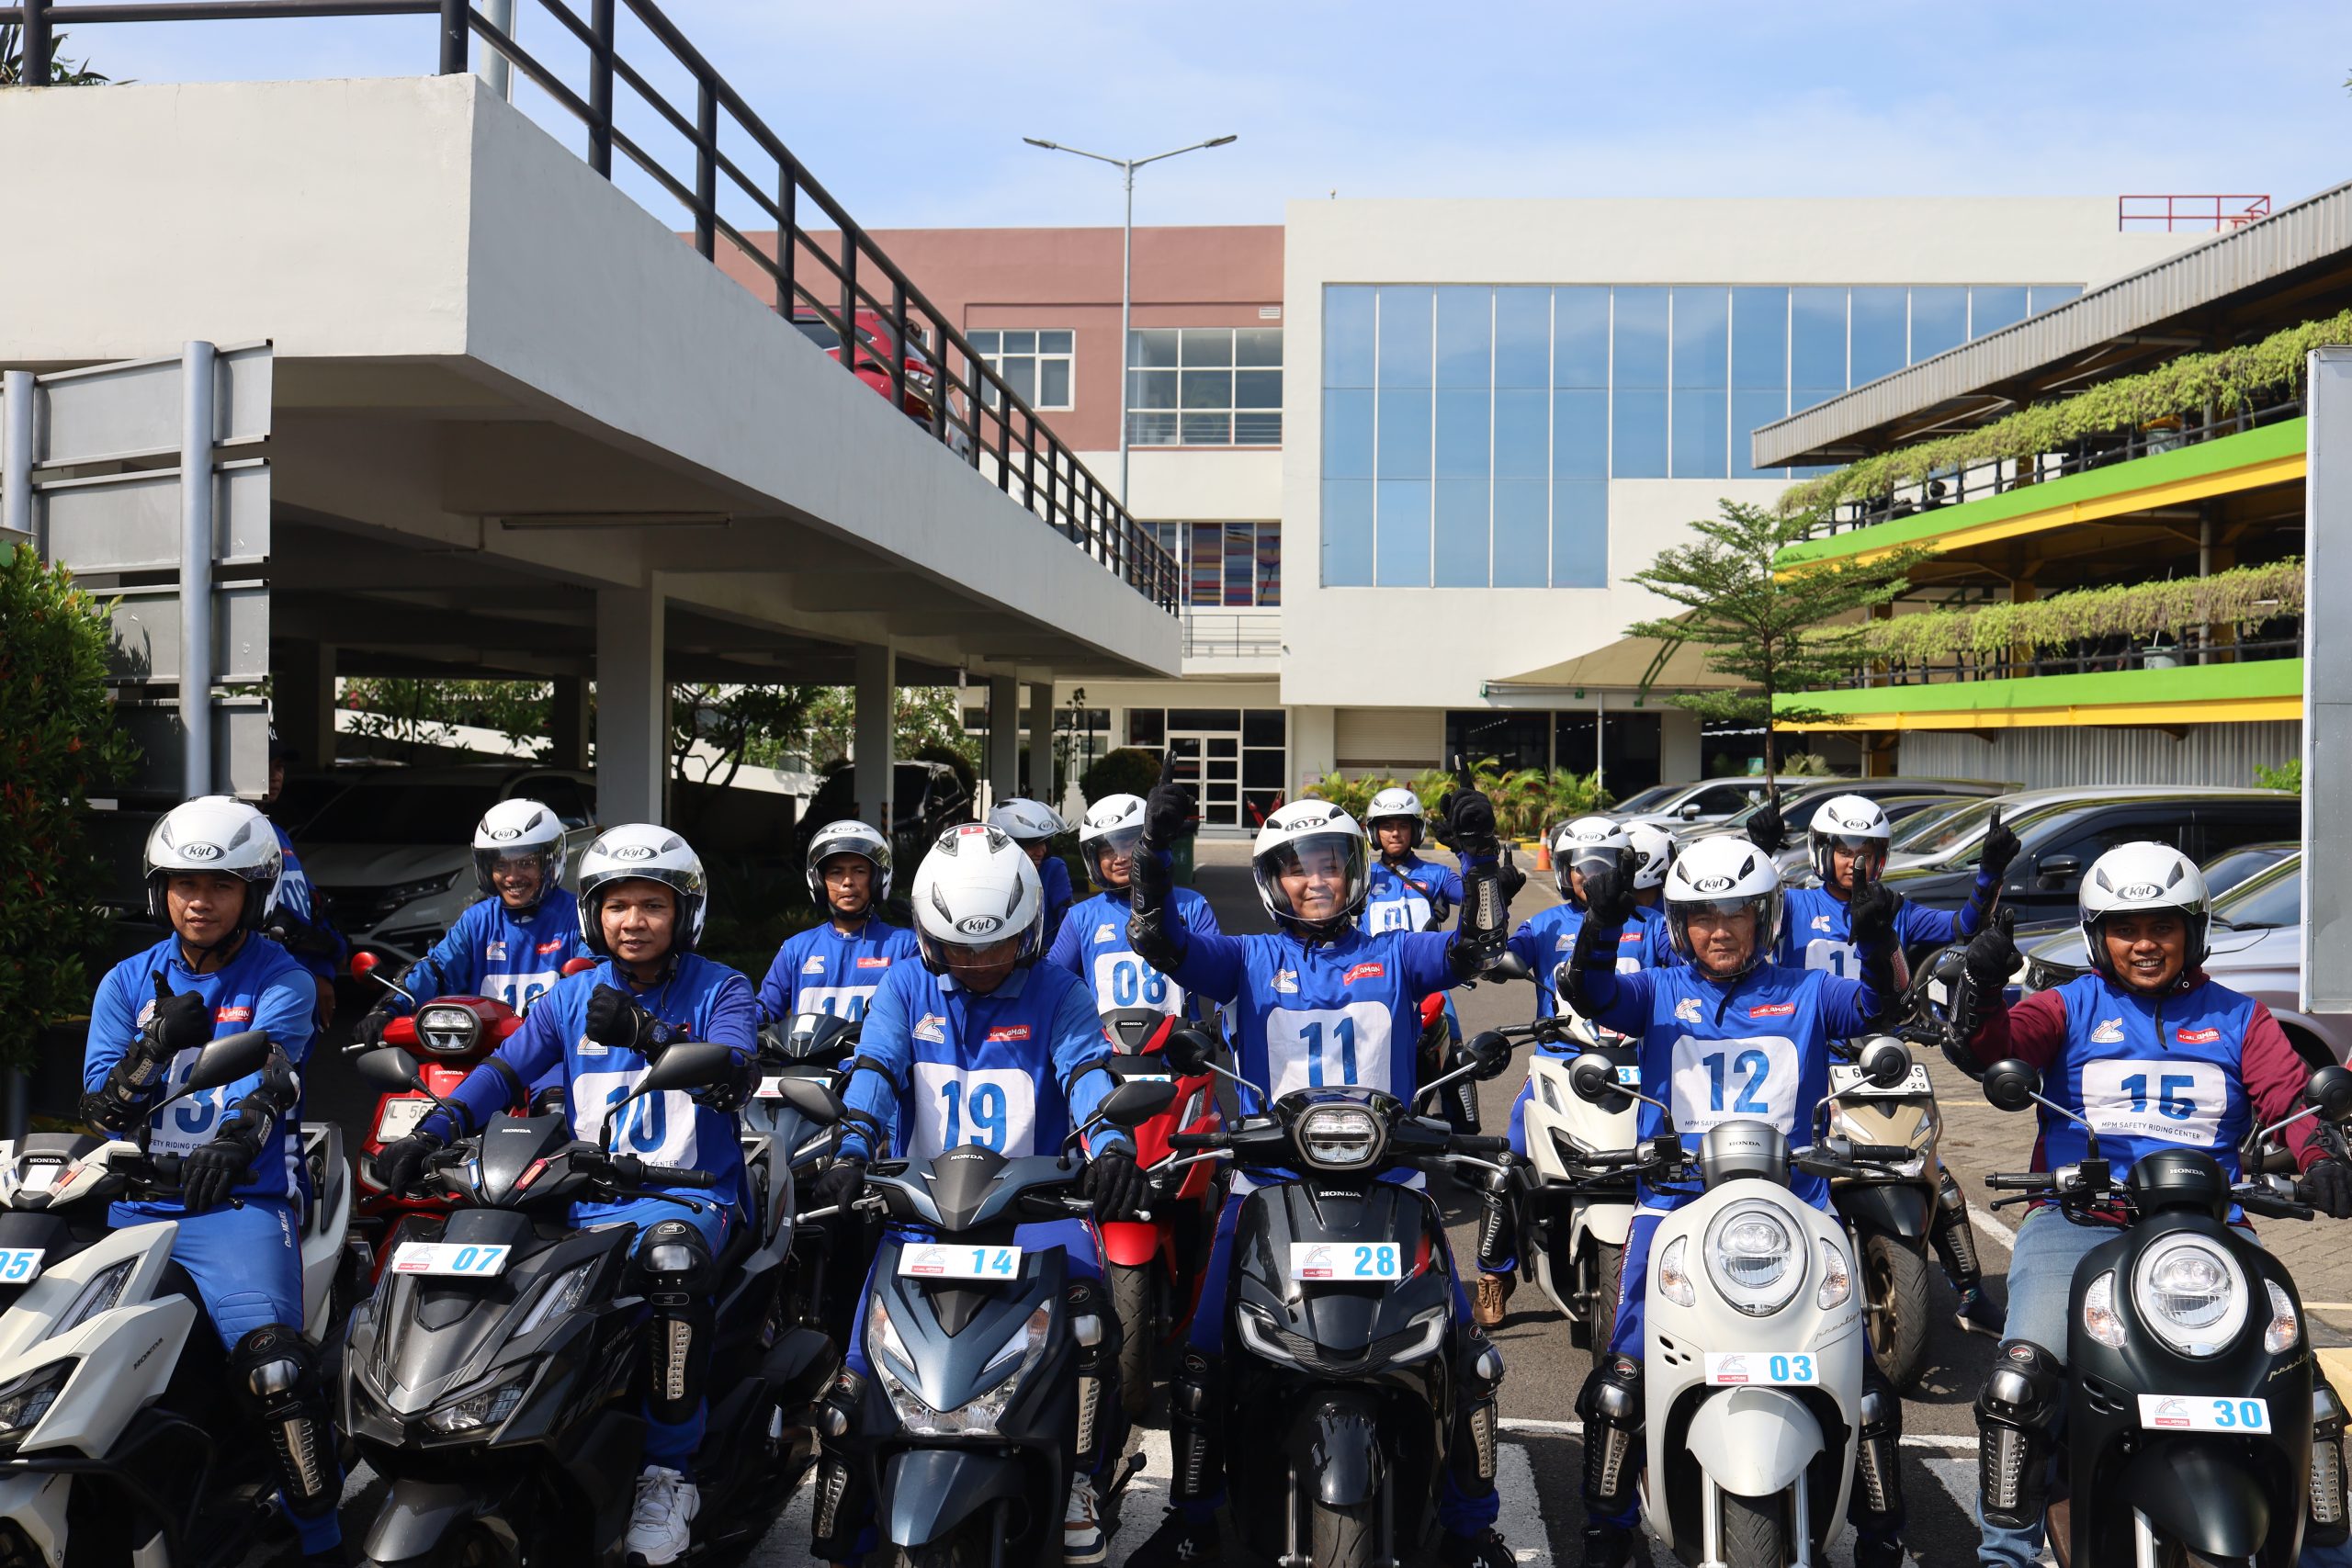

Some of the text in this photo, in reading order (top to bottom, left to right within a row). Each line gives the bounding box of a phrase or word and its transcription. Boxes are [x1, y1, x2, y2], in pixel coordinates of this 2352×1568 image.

[188, 841, 213, 858] Kyt
[967, 919, 991, 931] Kyt
[1113, 960, 1167, 1007] 08
[1299, 1016, 1358, 1089] 11
[1702, 1049, 1770, 1113] 12
[2120, 1073, 2198, 1121] 15
[605, 1085, 667, 1153] 10
[941, 1079, 1007, 1154] 19
[2101, 1121, 2201, 1140] MPM SAFETY RIDING CENTER
[165, 1141, 190, 1150] RIDING
[28, 1156, 62, 1165] HONDA
[2169, 1168, 2206, 1177] HONDA
[451, 1246, 503, 1271] 07
[971, 1248, 1012, 1275] 14
[1353, 1246, 1396, 1277] 28
[1769, 1354, 1813, 1382] 03
[2212, 1399, 2263, 1428] 30
